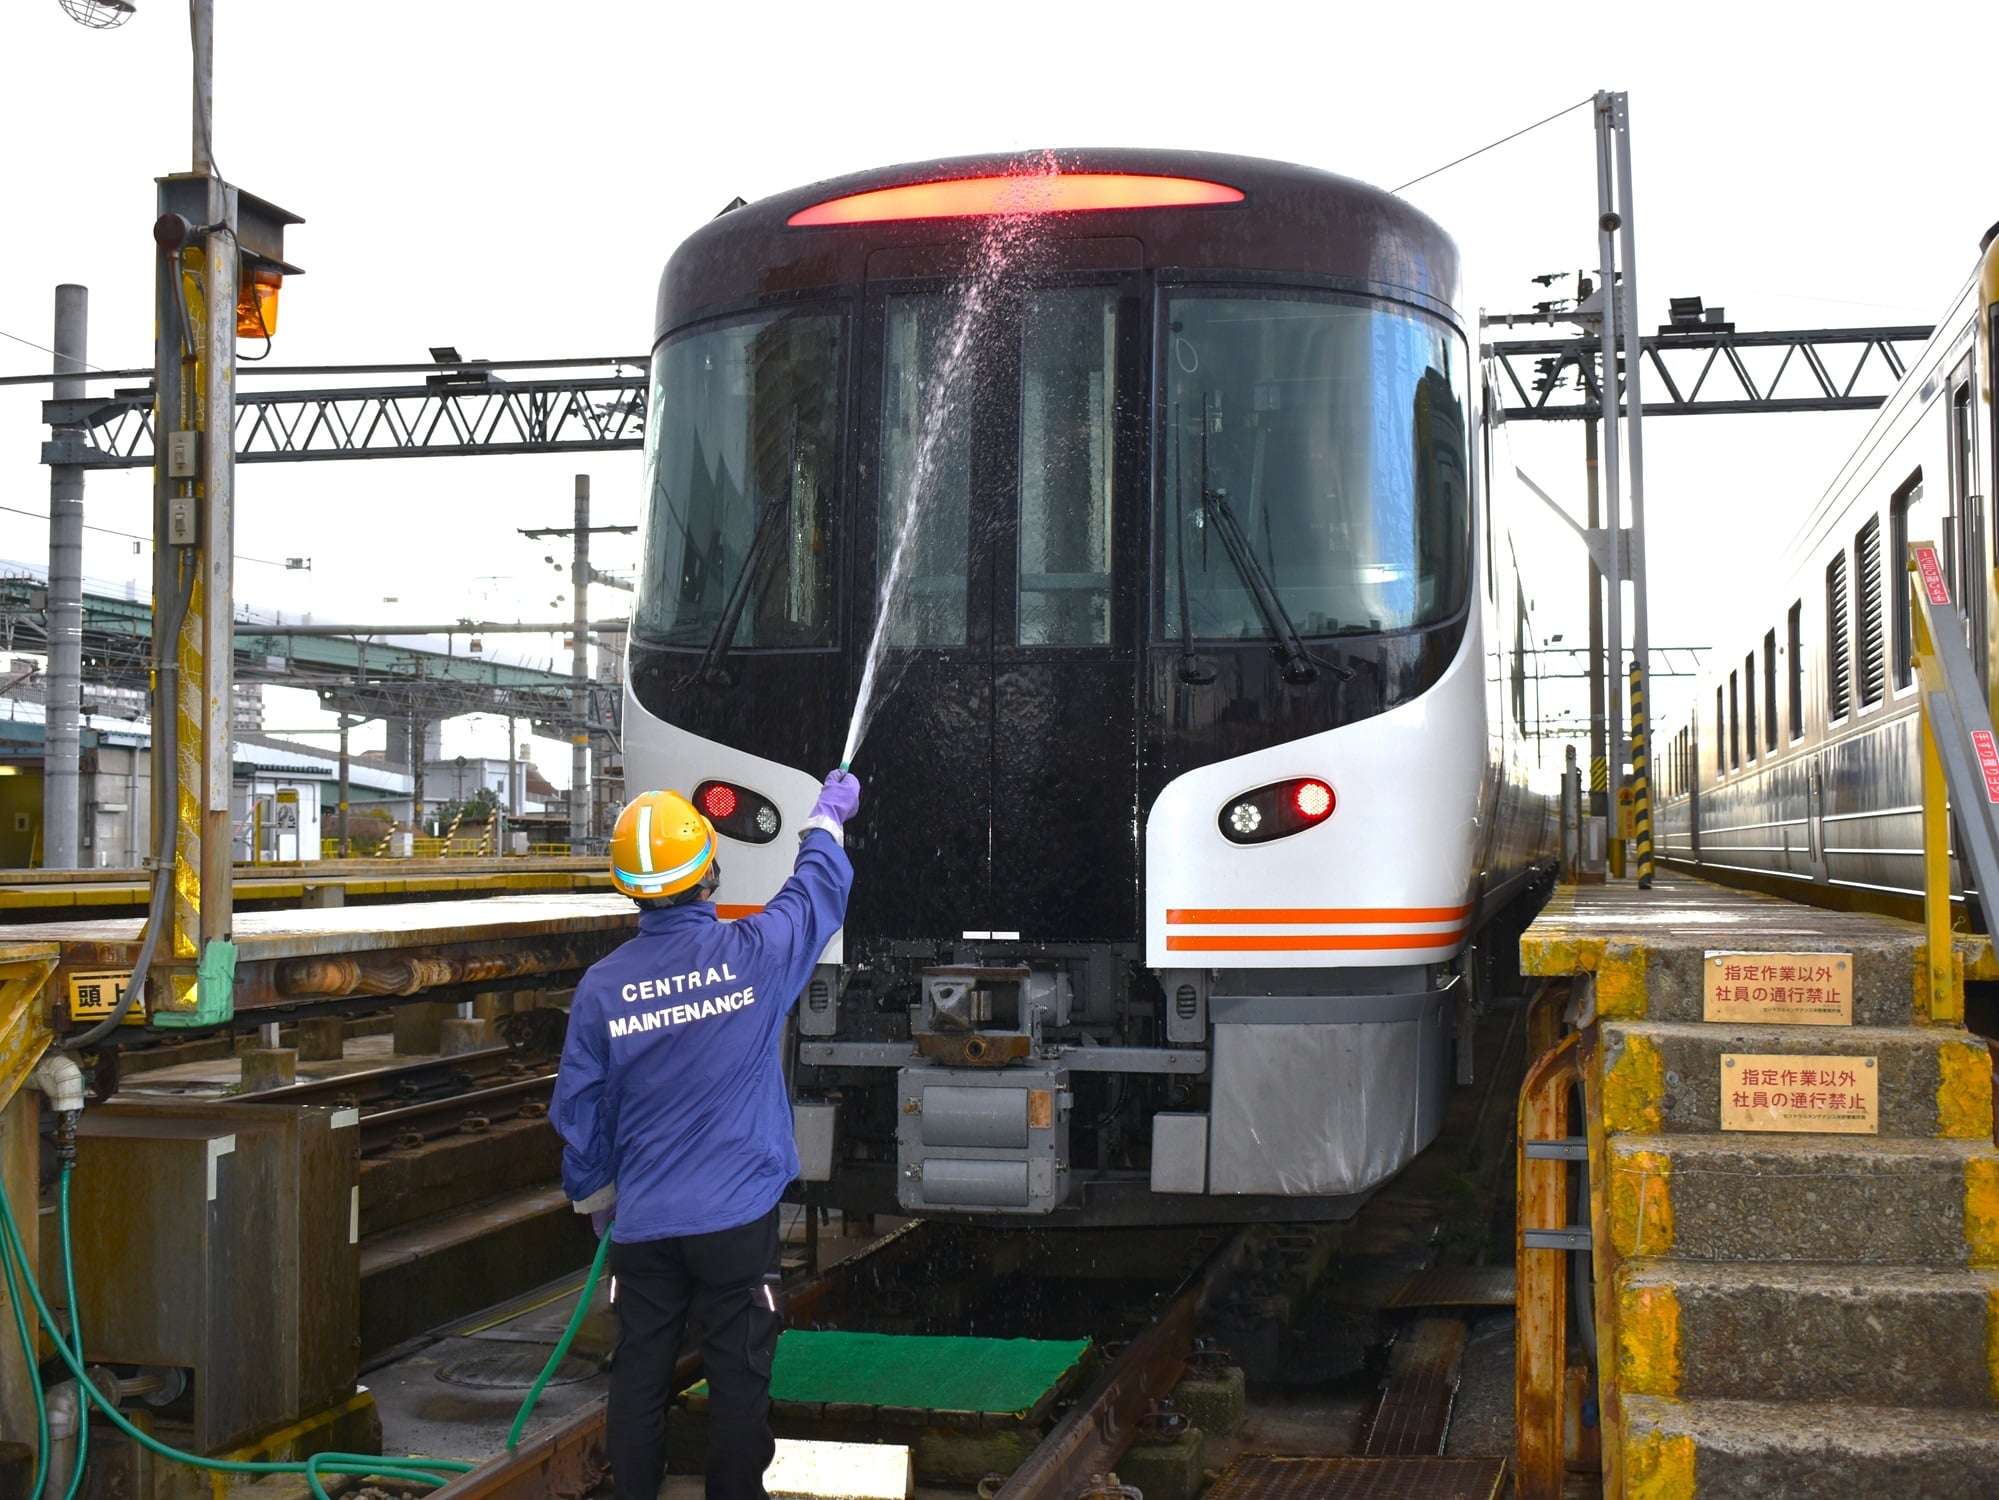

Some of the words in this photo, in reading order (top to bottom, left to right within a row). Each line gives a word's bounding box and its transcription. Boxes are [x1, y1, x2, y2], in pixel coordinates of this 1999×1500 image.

[622, 963, 737, 1002] CENTRAL
[1724, 964, 1832, 983] 指定作業以外
[1715, 985, 1841, 1004] 社員の通行禁止
[608, 986, 755, 1038] MAINTENANCE
[1742, 1068, 1856, 1087] 指定作業以外
[1732, 1091, 1866, 1110] 社員の通行禁止
